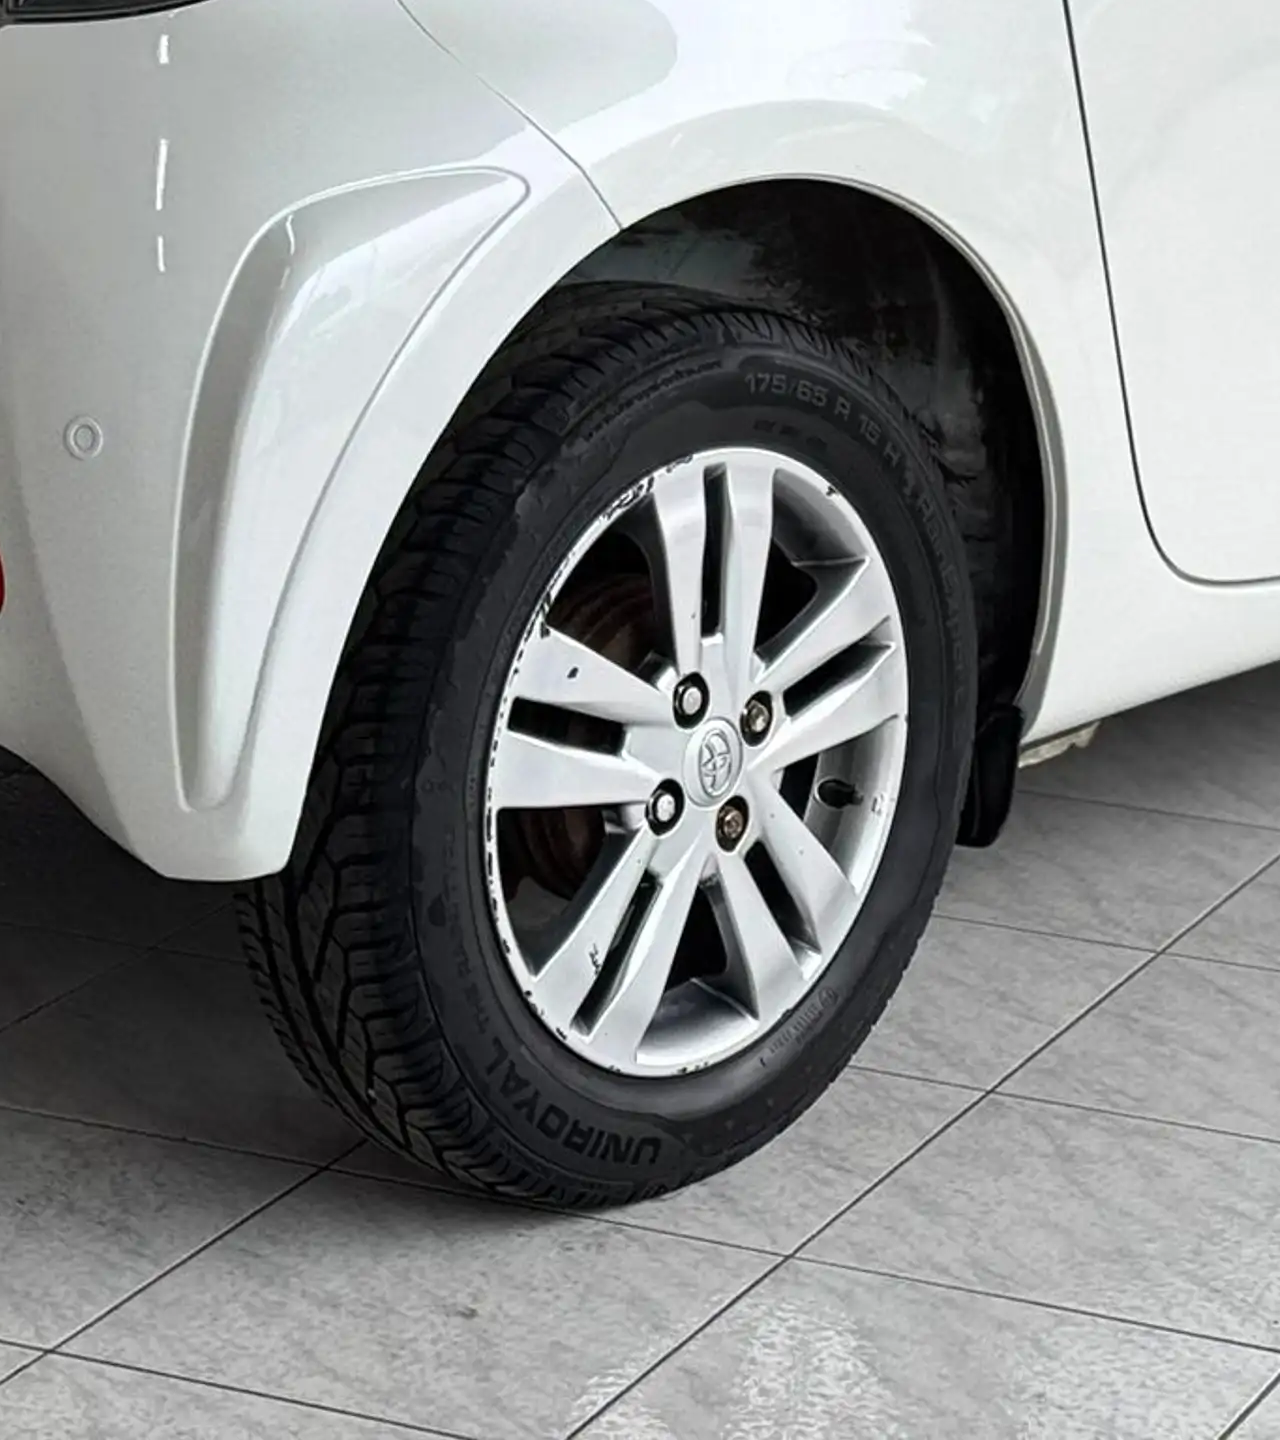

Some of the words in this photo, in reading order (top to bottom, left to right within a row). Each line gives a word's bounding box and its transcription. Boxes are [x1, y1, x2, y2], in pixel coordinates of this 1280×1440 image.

[744, 371, 829, 409] 175/65
[834, 398, 853, 421] R
[856, 415, 882, 443] 15
[882, 442, 901, 468] H
[484, 1035, 661, 1166] UNIROYAL
